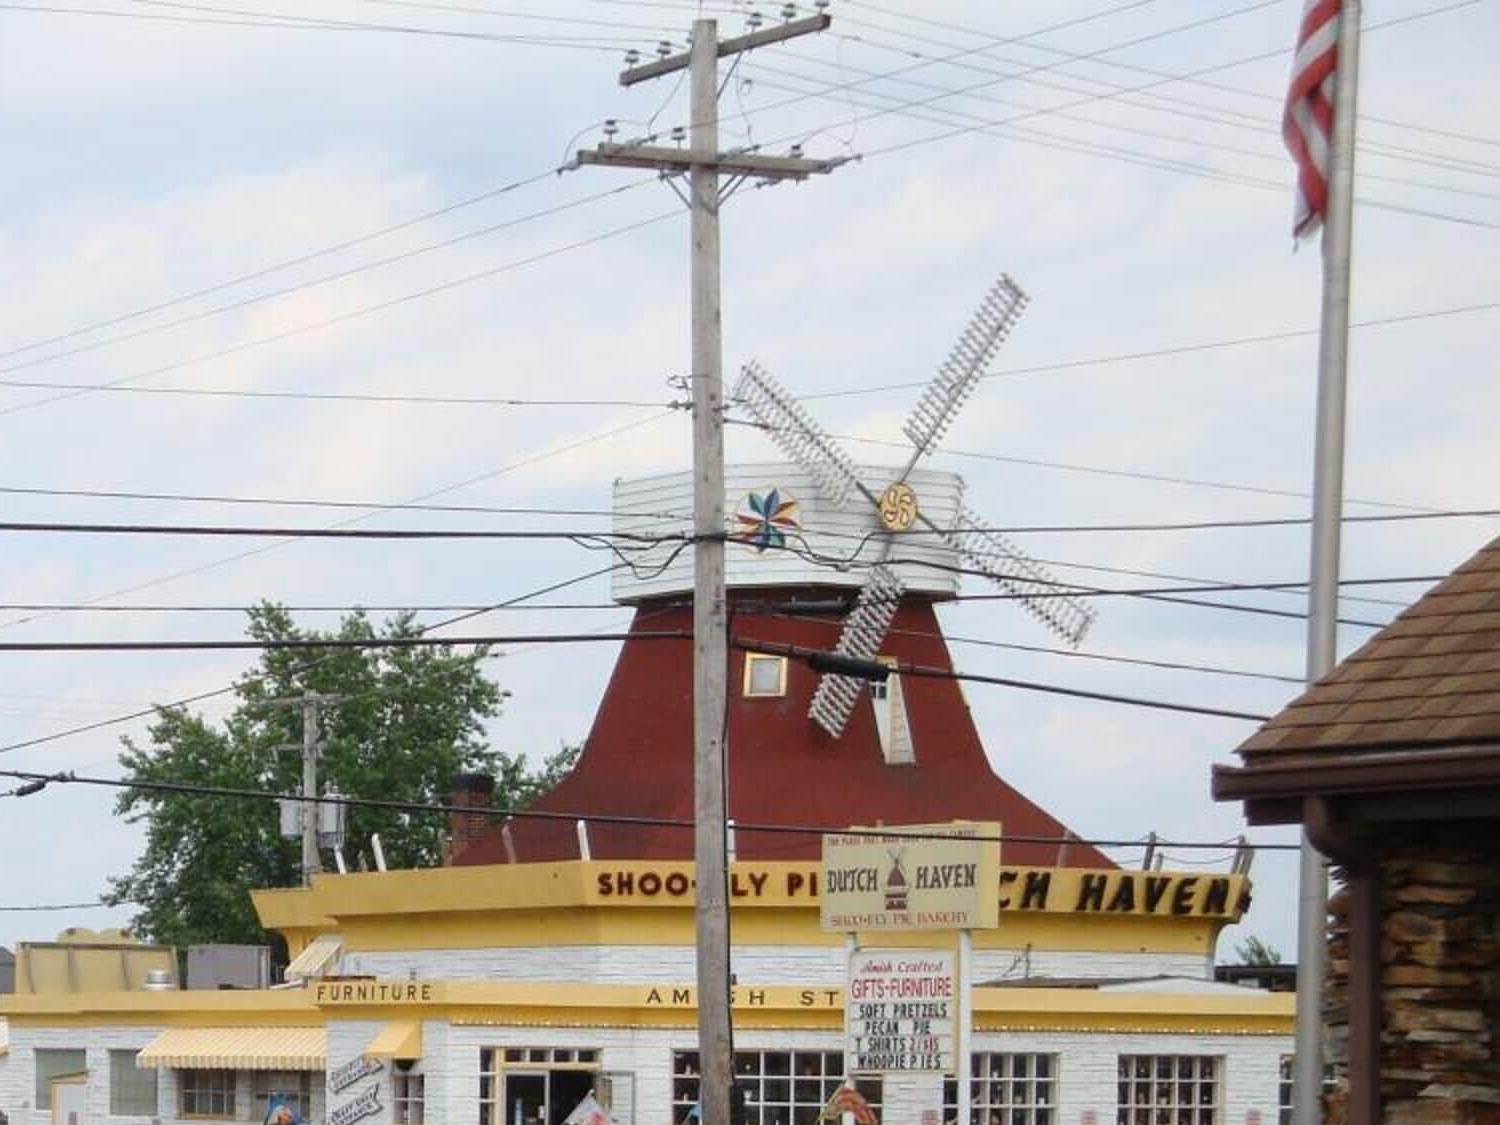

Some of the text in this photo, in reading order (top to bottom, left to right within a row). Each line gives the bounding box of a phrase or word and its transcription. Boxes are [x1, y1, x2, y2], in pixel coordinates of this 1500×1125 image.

[827, 863, 977, 894] DUTCH HAVEN
[1075, 873, 1231, 915] HAVEN
[893, 912, 910, 926] PIE
[916, 911, 968, 925] BAKERY
[897, 960, 943, 974] Crafted
[316, 984, 432, 1001] FURNITURE
[859, 1002, 947, 1018] SOFT PRETZELS
[865, 1021, 931, 1035] PECAN PIE
[867, 1037, 906, 1052] SHIRTS
[857, 1055, 941, 1070] WHOOPIE PIES
